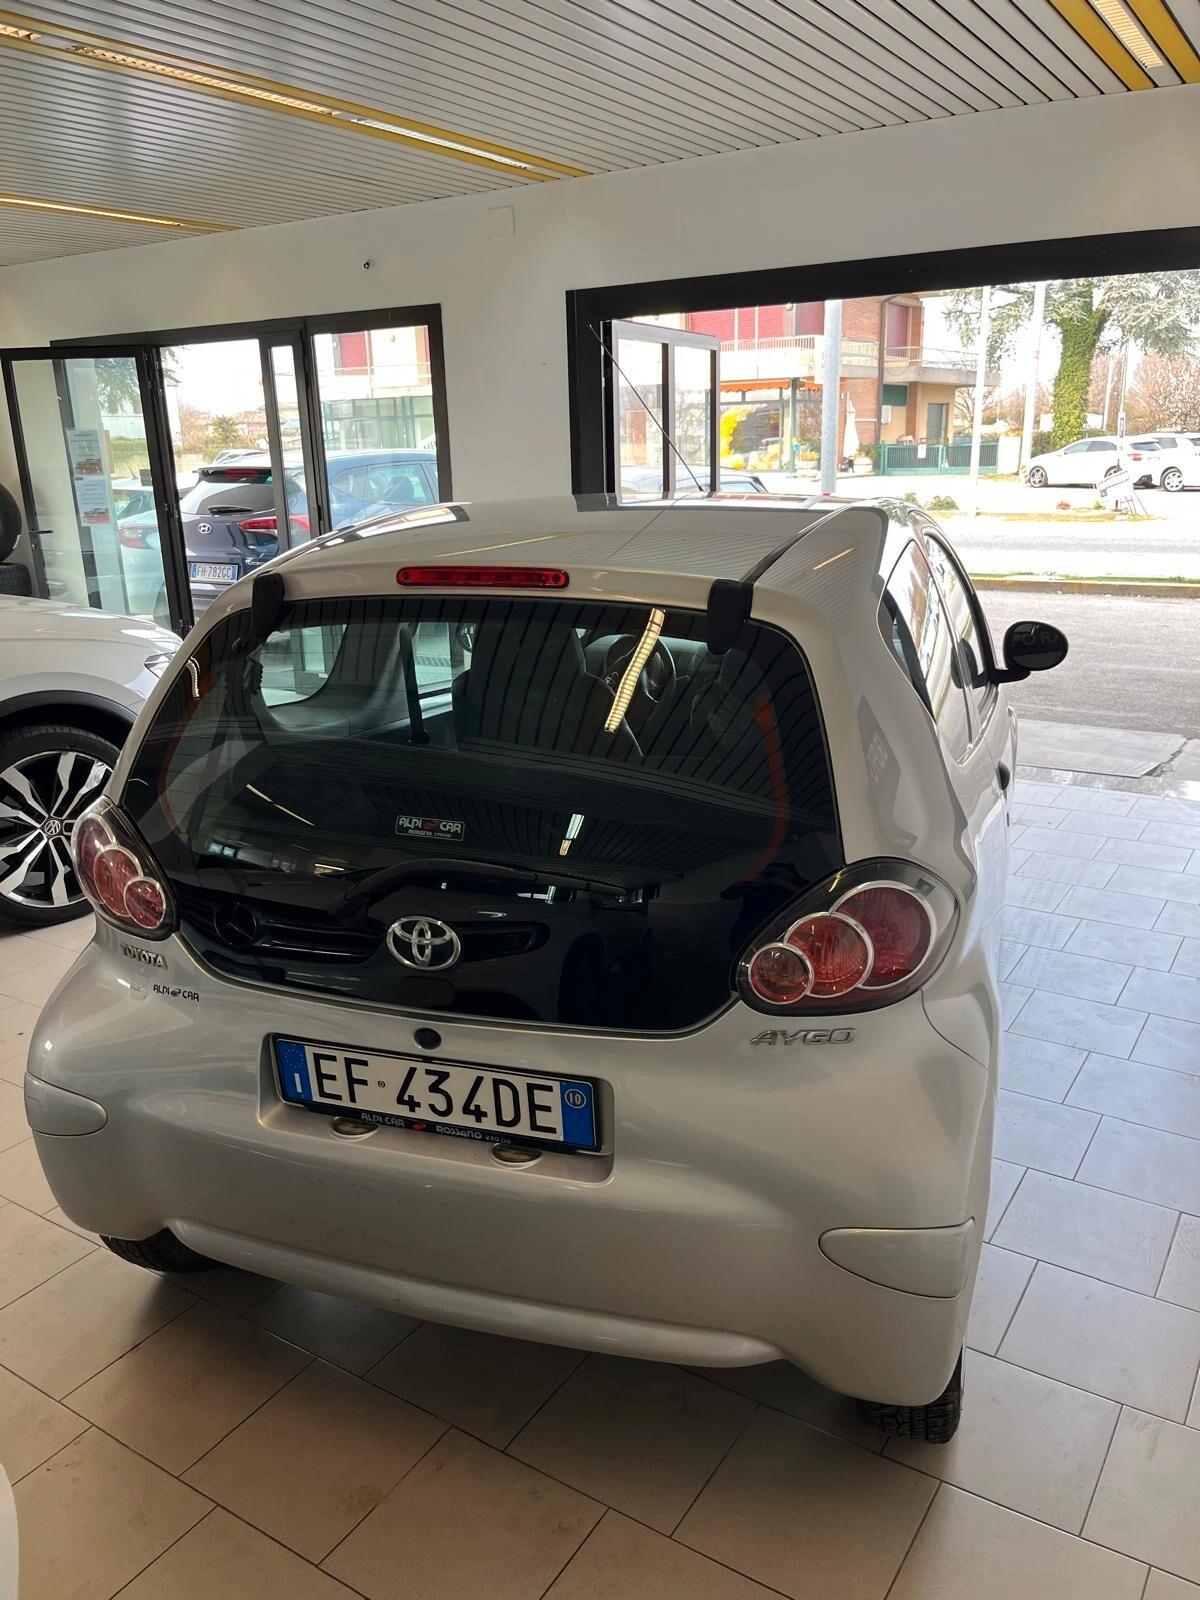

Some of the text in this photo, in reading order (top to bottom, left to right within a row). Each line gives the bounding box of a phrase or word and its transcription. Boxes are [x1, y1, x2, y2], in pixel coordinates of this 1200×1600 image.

[399, 817, 462, 834] ALPI CAR
[120, 943, 168, 970] TOYOTA
[153, 984, 200, 1002] ALPI CAR
[750, 1028, 856, 1046] AYGO
[313, 1052, 557, 1135] EF 434DE
[569, 1092, 582, 1105] 10
[361, 1112, 382, 1123] ALPI
[384, 1117, 405, 1128] CAR
[436, 1125, 483, 1140] ROSSANO
